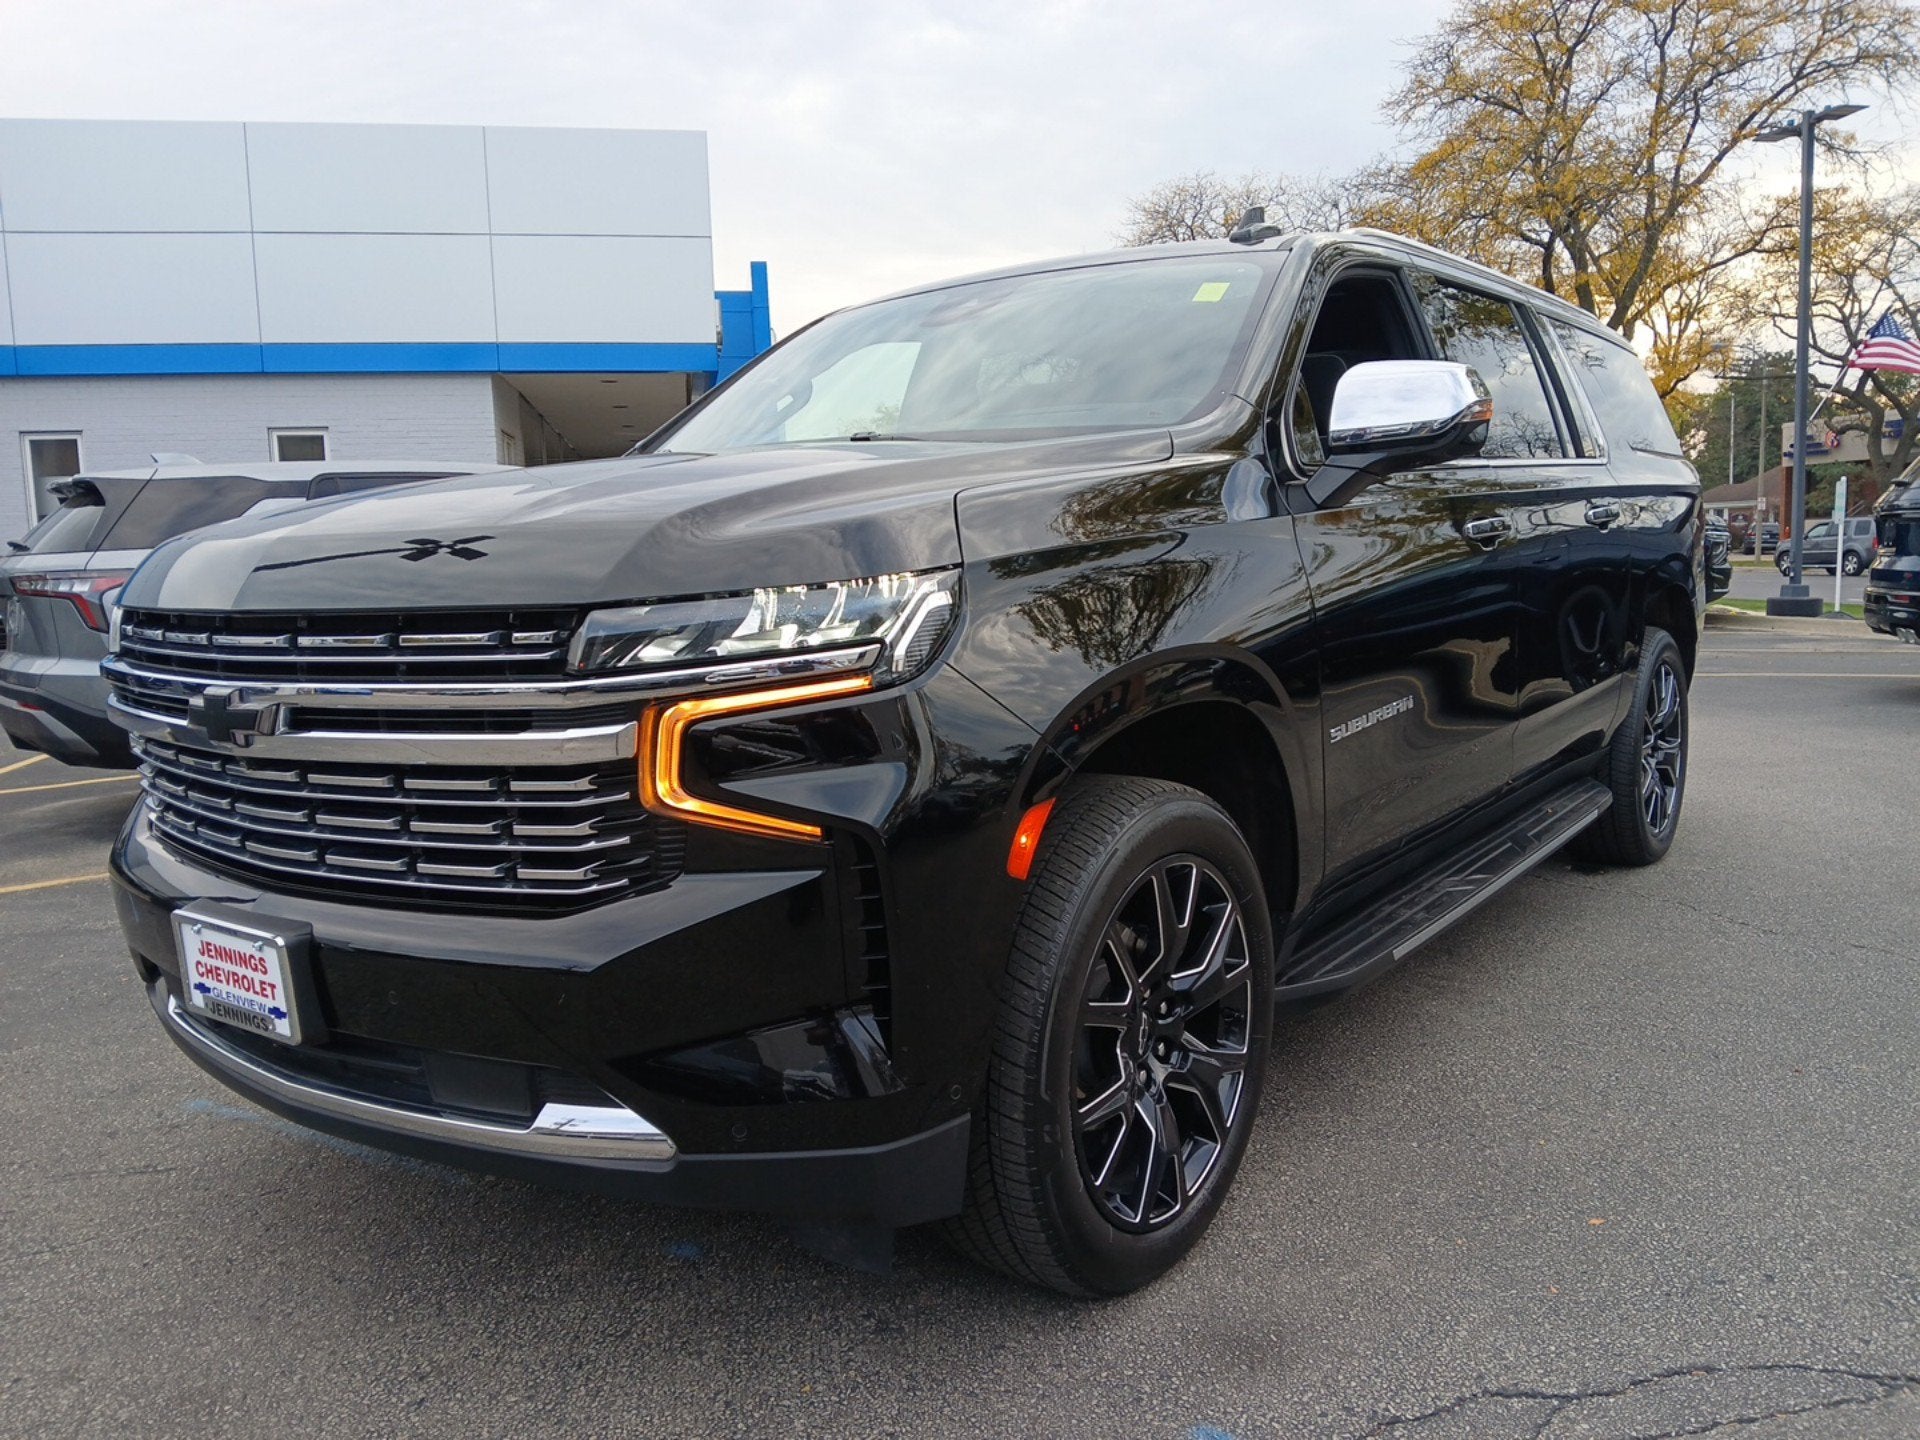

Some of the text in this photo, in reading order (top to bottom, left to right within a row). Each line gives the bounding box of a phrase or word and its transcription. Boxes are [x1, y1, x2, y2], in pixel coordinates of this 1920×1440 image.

[1330, 695, 1414, 743] SUBURBAN
[198, 940, 268, 975] JENNINGS
[195, 961, 276, 1001] CHEVROLET
[209, 1001, 269, 1032] JENNINGS
[212, 987, 267, 1013] GLENVIEW
